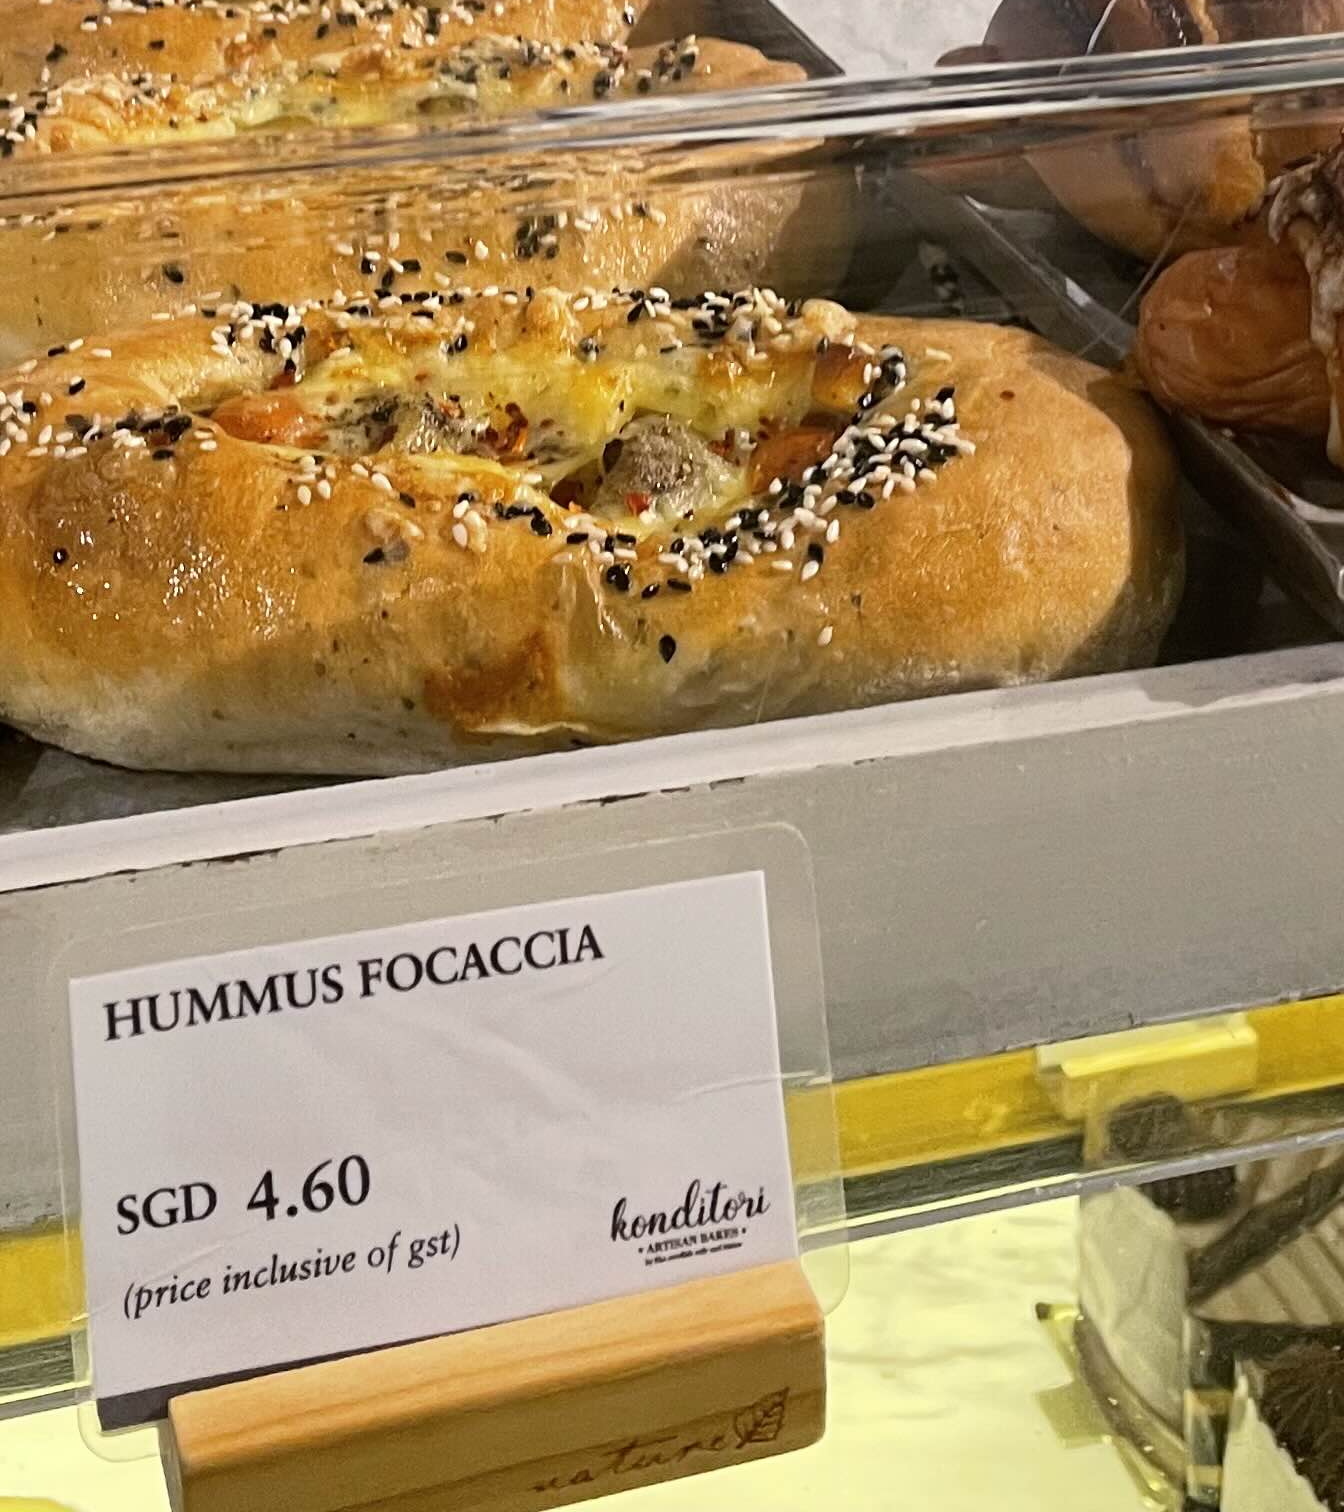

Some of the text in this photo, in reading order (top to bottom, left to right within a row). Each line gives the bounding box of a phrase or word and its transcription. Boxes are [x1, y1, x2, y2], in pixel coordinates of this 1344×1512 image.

[103, 924, 605, 1041] HUMMUS FOCACCIA
[115, 1154, 370, 1236] SGD 4.60
[611, 1178, 771, 1242] konditori
[123, 1223, 461, 1319] (price inclusive of gst)
[646, 1235, 698, 1255] ARTISAN
